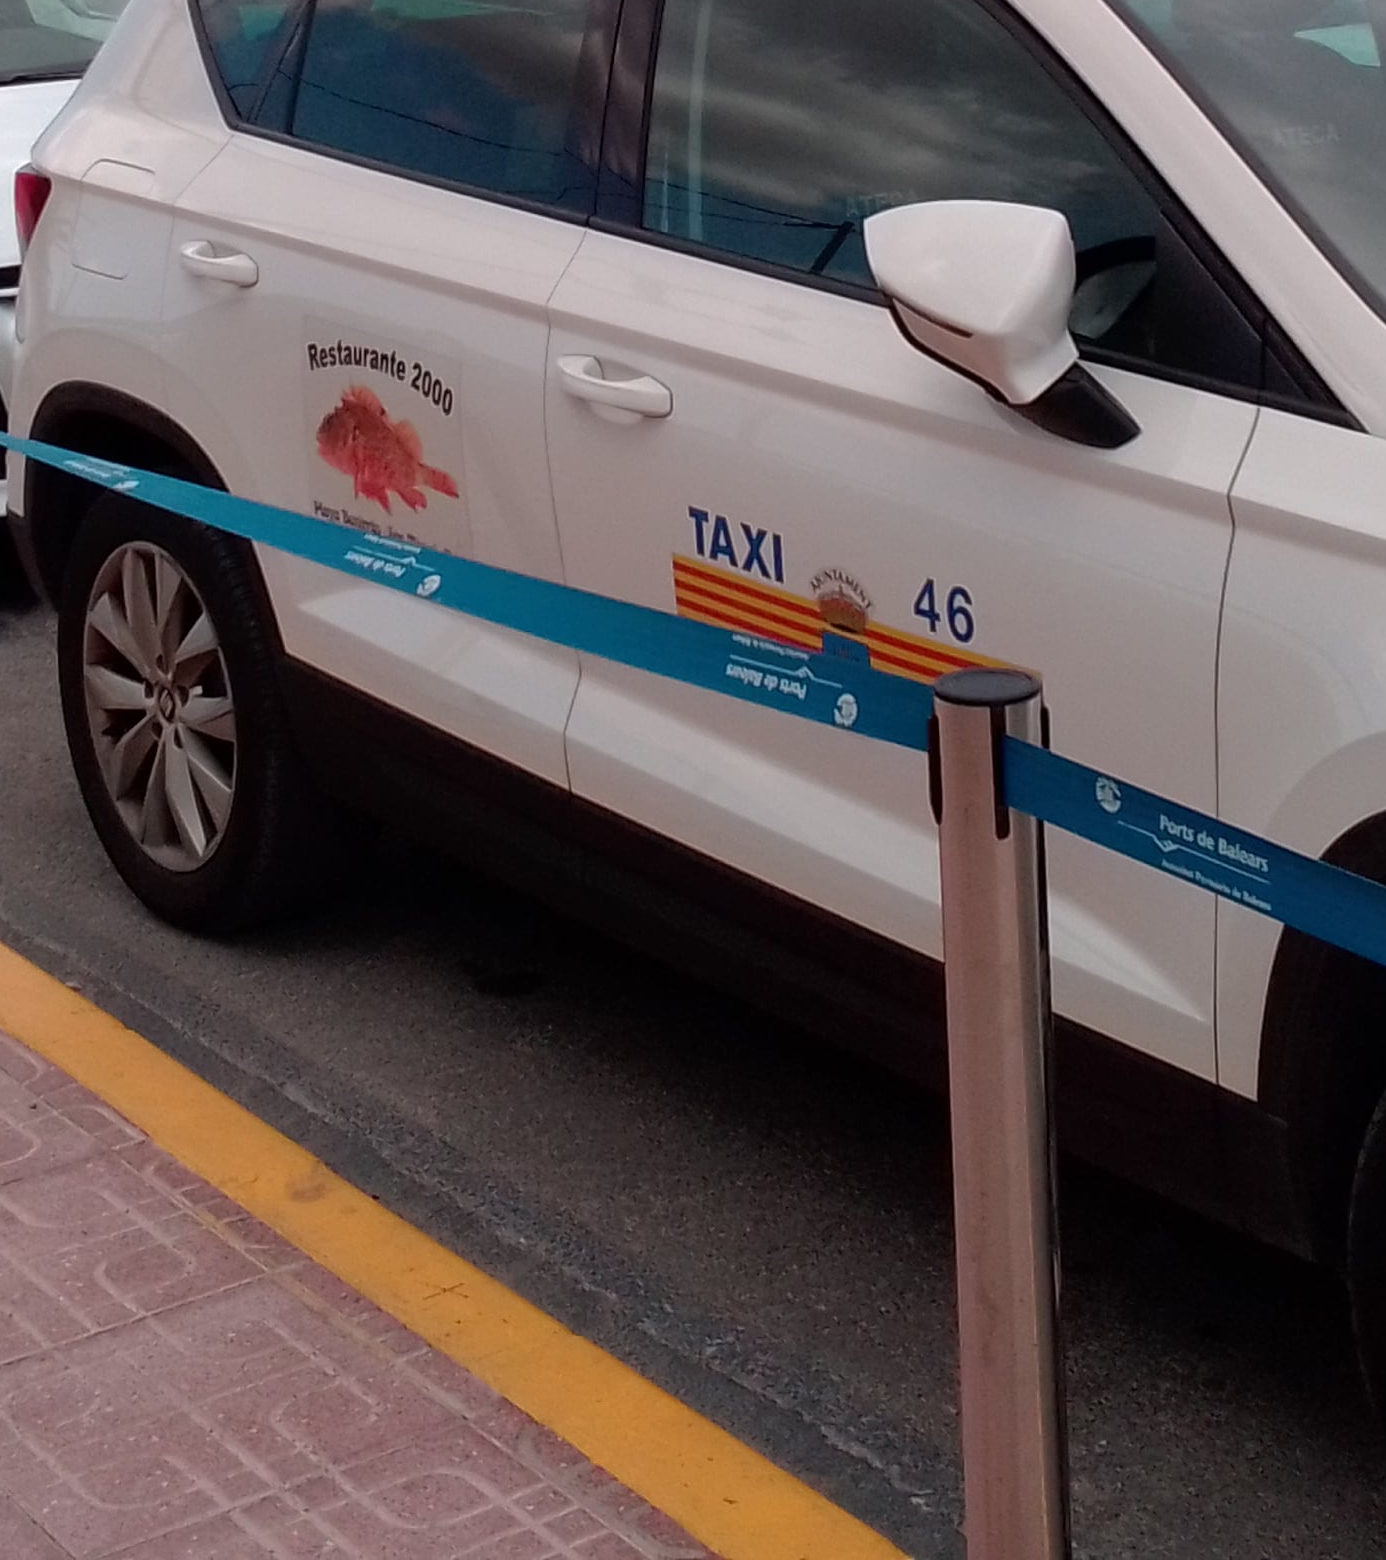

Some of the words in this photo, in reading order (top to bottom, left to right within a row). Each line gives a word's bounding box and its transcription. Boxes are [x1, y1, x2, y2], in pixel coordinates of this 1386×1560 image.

[307, 340, 406, 381] Restaurante
[410, 362, 454, 416] 2000
[688, 506, 785, 584] TAXI
[810, 569, 873, 610] AJUNTAMENT
[913, 578, 974, 644] 46
[764, 674, 779, 692] de
[779, 679, 807, 700] Ports
[1159, 814, 1195, 843] Ports
[1197, 830, 1214, 850] de
[1218, 837, 1269, 872] Balears
